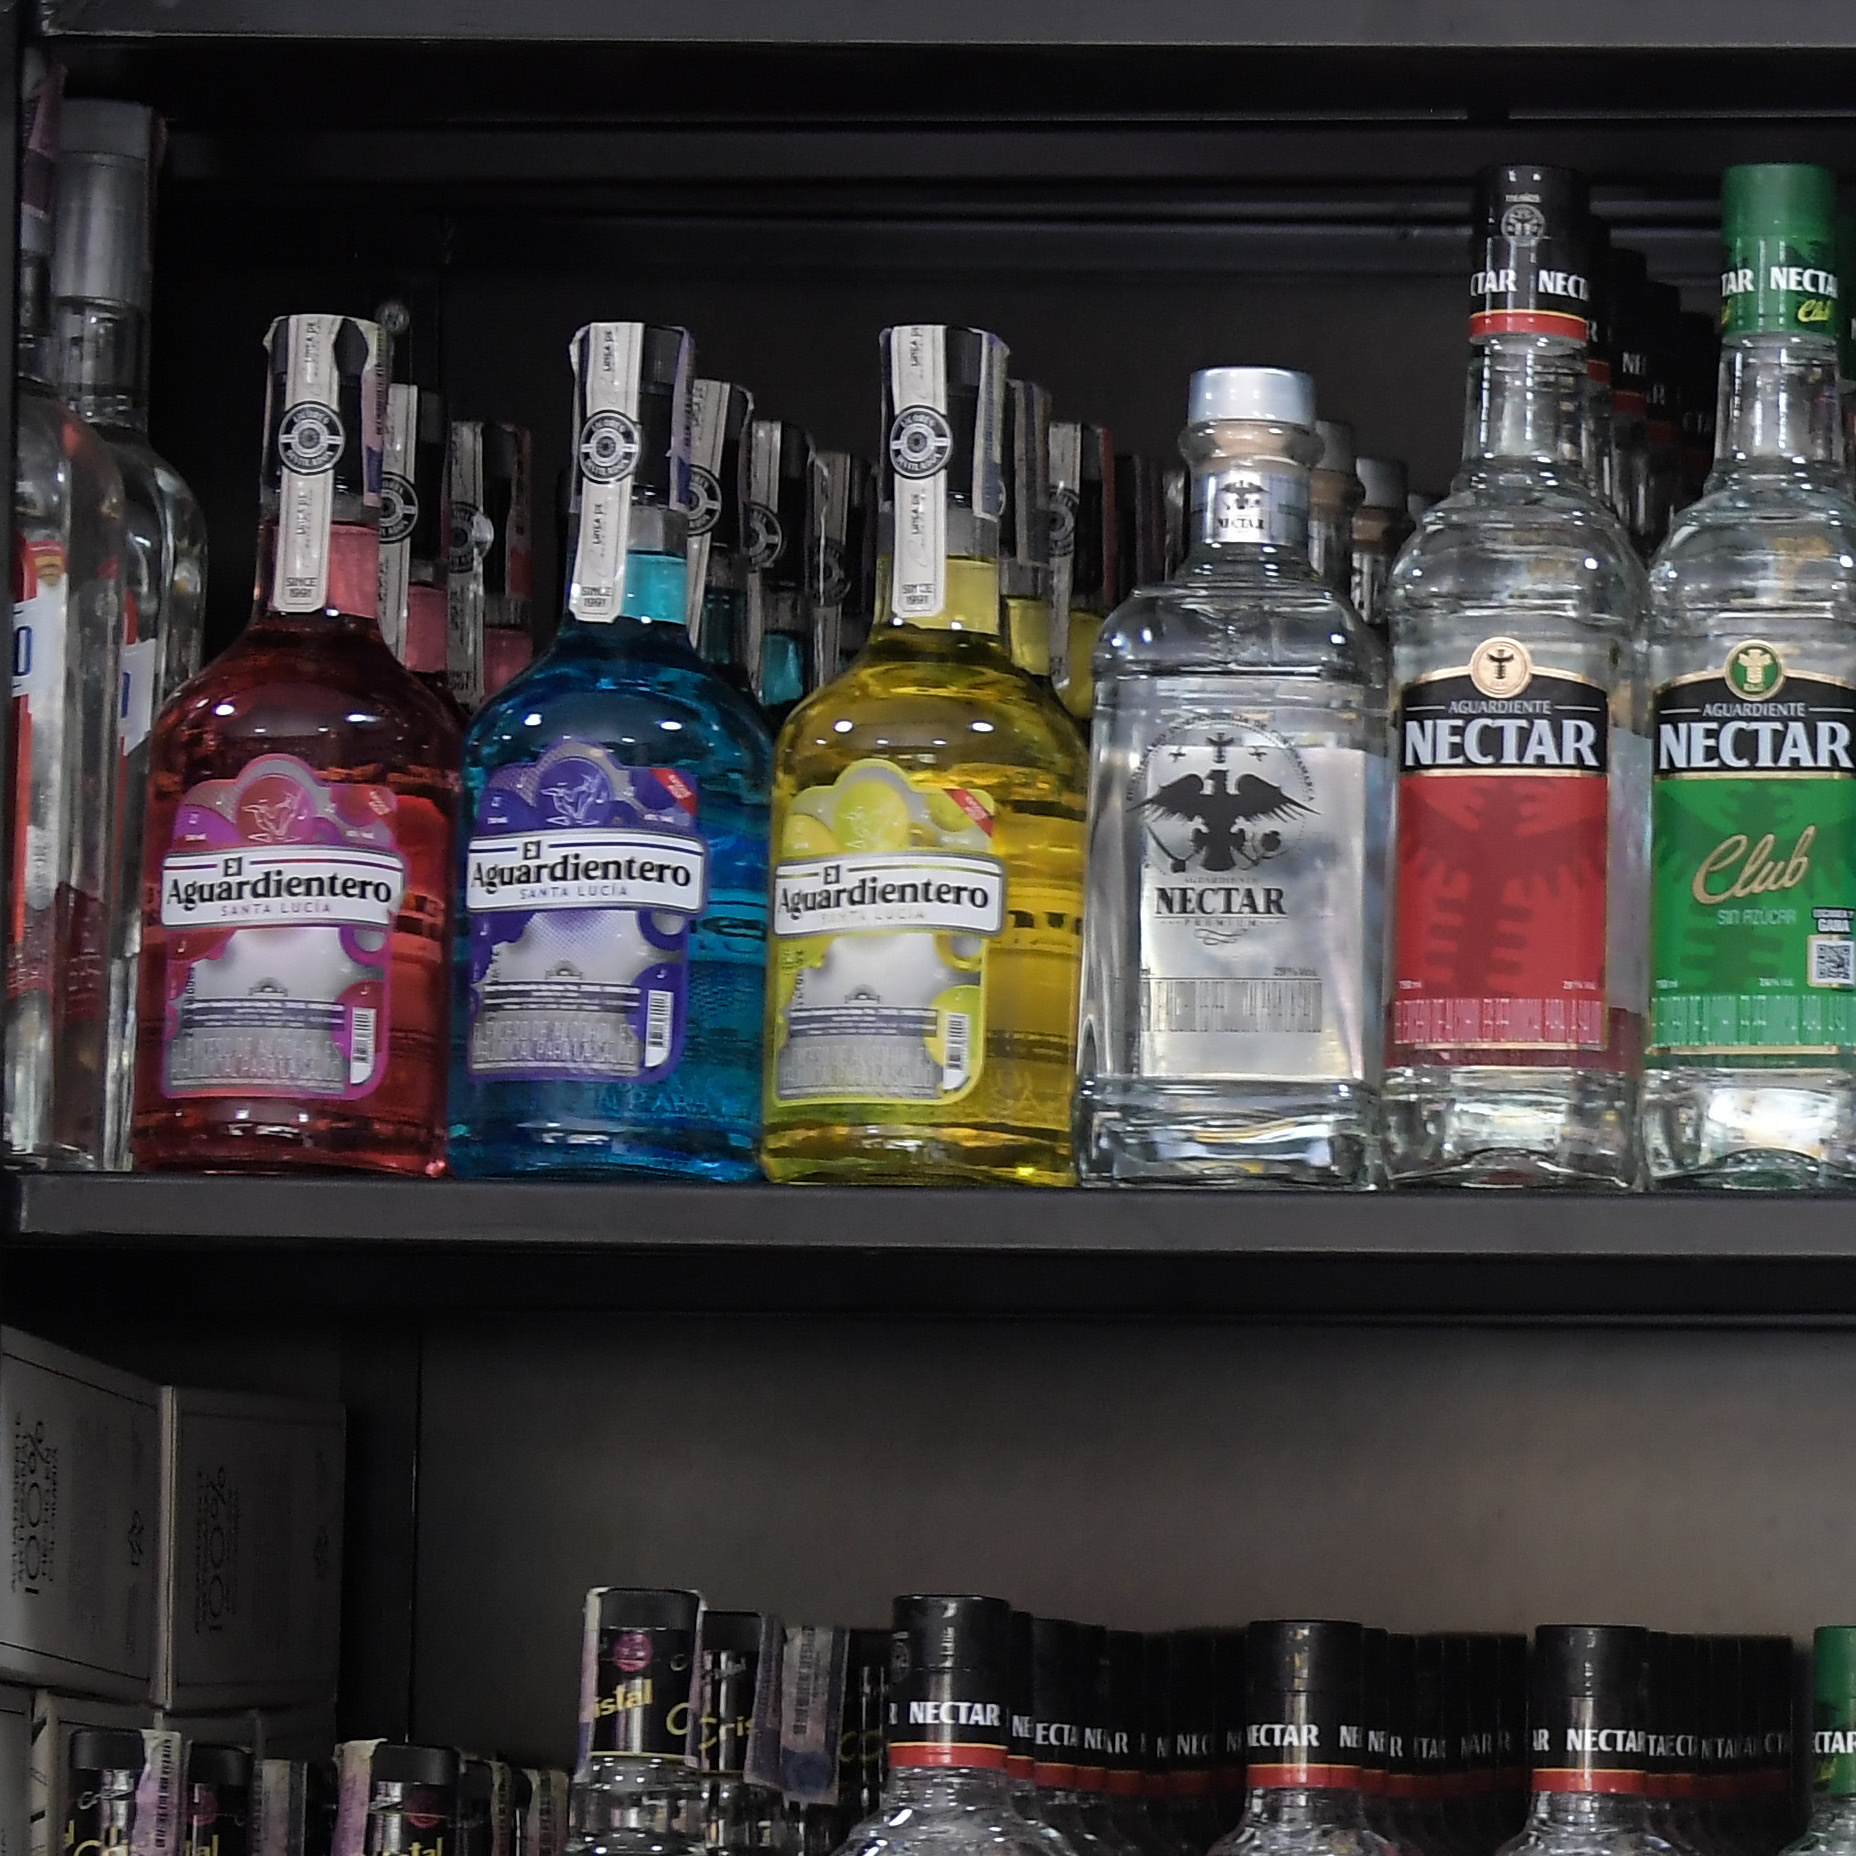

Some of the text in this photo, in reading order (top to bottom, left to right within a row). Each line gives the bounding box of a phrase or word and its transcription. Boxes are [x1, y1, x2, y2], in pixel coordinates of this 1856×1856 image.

[1447, 699, 1552, 716] AGUARDIENTE
[1702, 702, 1806, 718] AGUARDIENTE
[1403, 717, 1600, 768] NECTAR
[1658, 720, 1856, 770] NECTAR
[523, 841, 542, 861] El
[223, 856, 243, 878] El
[471, 852, 692, 894] Aguardientero
[820, 865, 843, 885] El
[1692, 824, 1817, 906] Club
[165, 867, 392, 912] Aguardientero
[519, 884, 569, 899] SANTA
[775, 875, 990, 917] Aguardientero
[1154, 886, 1288, 916] NECTAR
[220, 902, 272, 917] SANTA
[909, 1701, 1001, 1727] NECTAR
